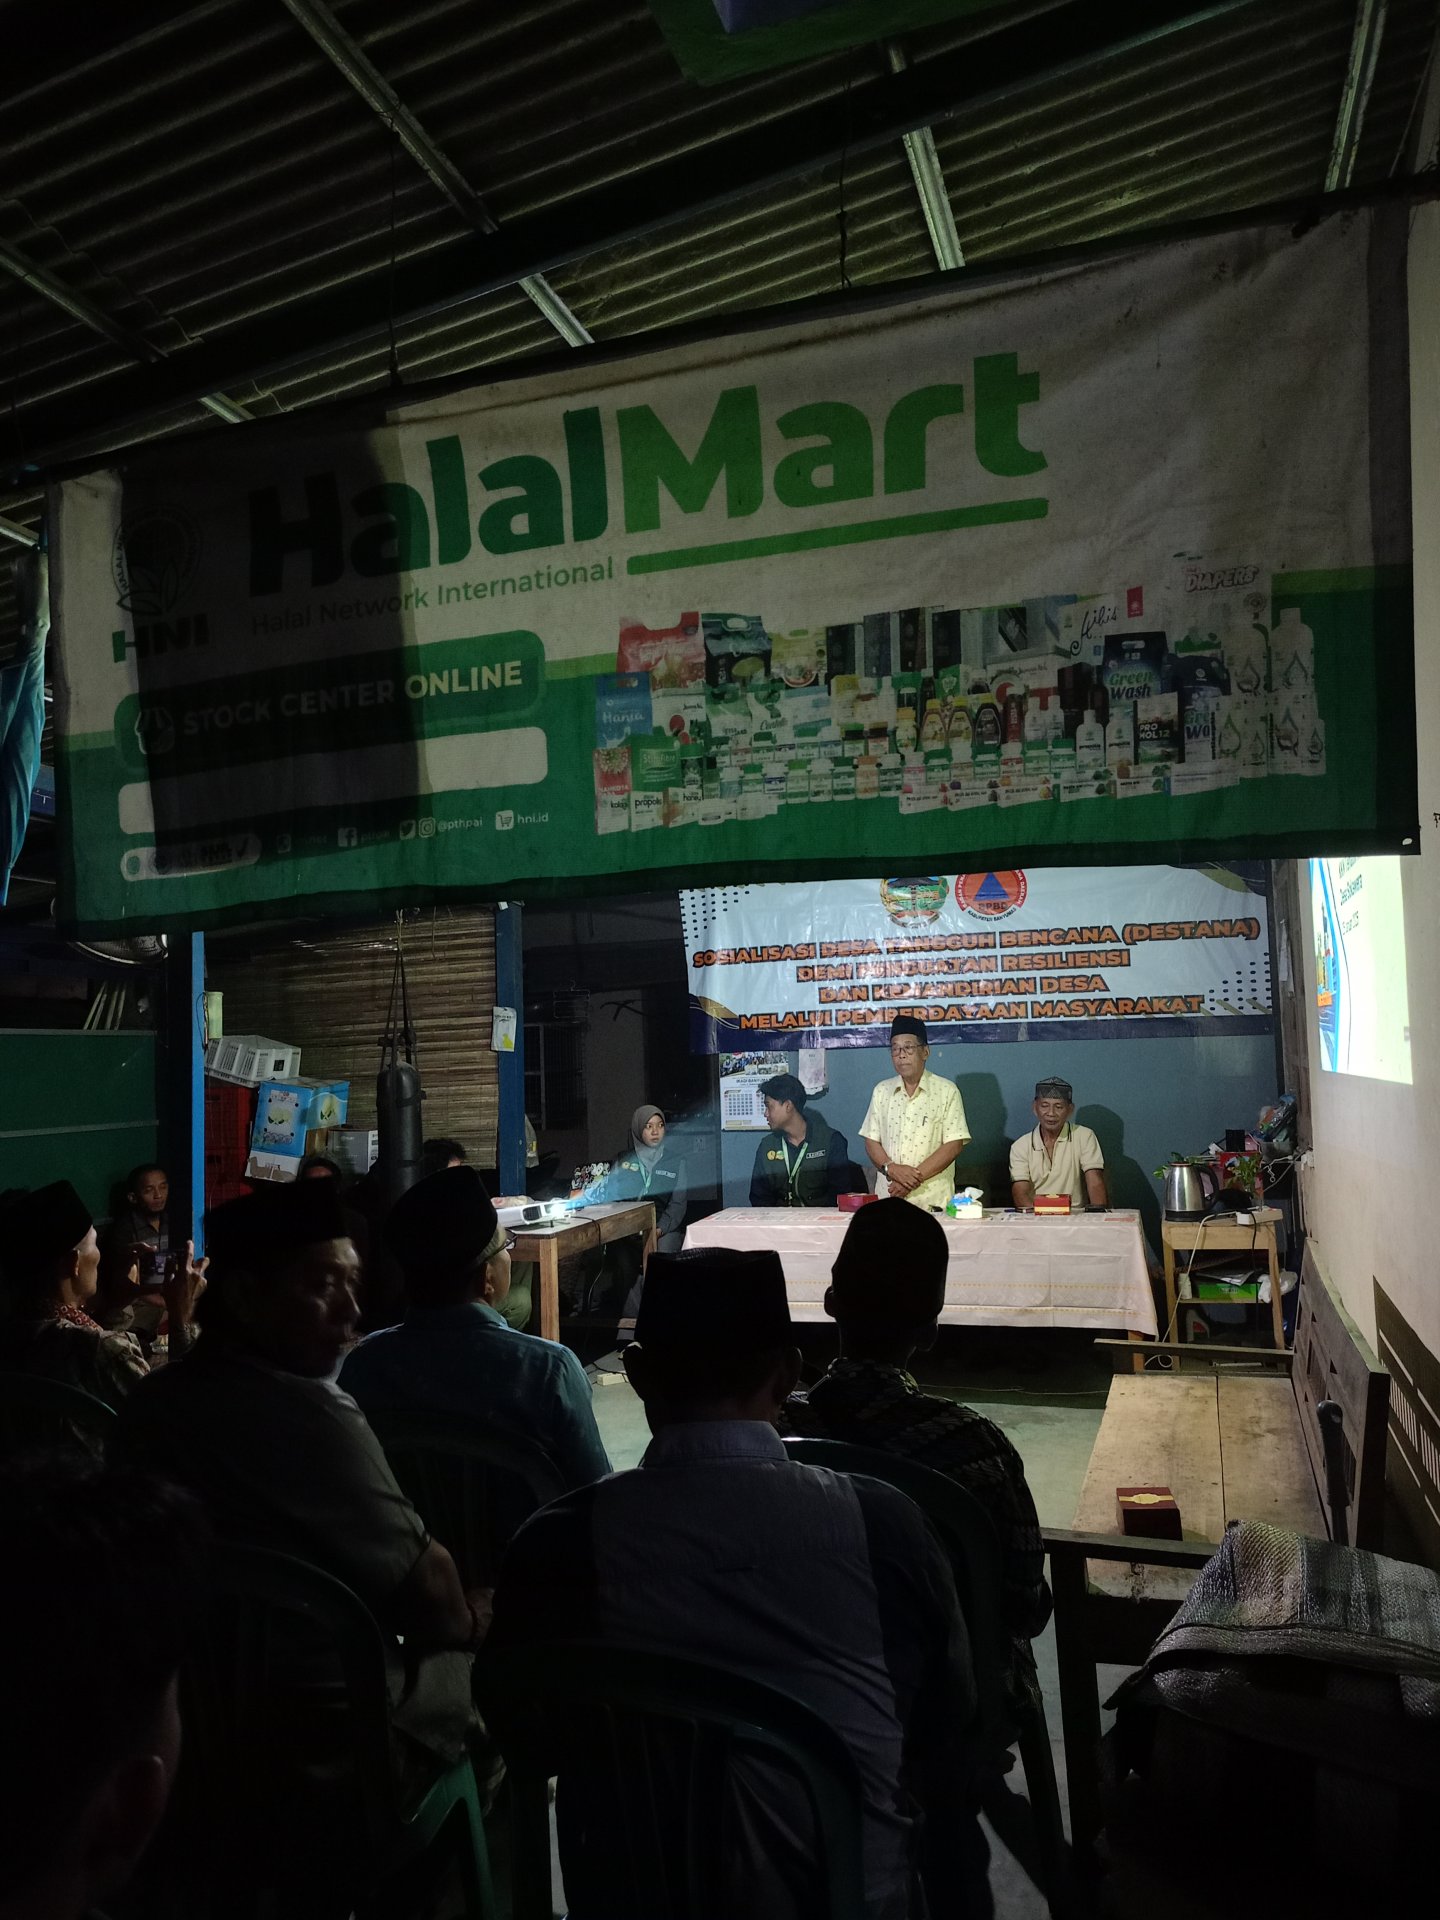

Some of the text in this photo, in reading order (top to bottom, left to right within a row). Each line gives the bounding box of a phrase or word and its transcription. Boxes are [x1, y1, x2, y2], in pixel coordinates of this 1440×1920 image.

[248, 352, 1048, 597] HalalMart
[252, 556, 613, 635] Halal Network International
[112, 613, 210, 663] HNI
[183, 660, 522, 736] STOCK CENTER ONLINE
[1109, 669, 1153, 686] Green
[1110, 683, 1151, 700] Wash
[693, 917, 1260, 968] SOSIALISASI DESA TANGGUH BENCANA (DESTANA)
[797, 964, 853, 982] DEMI
[1001, 949, 1131, 972] RESILIENSI
[819, 985, 869, 1004] DAN
[1039, 974, 1110, 994] DESA
[739, 995, 1204, 1029] MELALUI PEMBERDAYAAN MASYARAKAT
